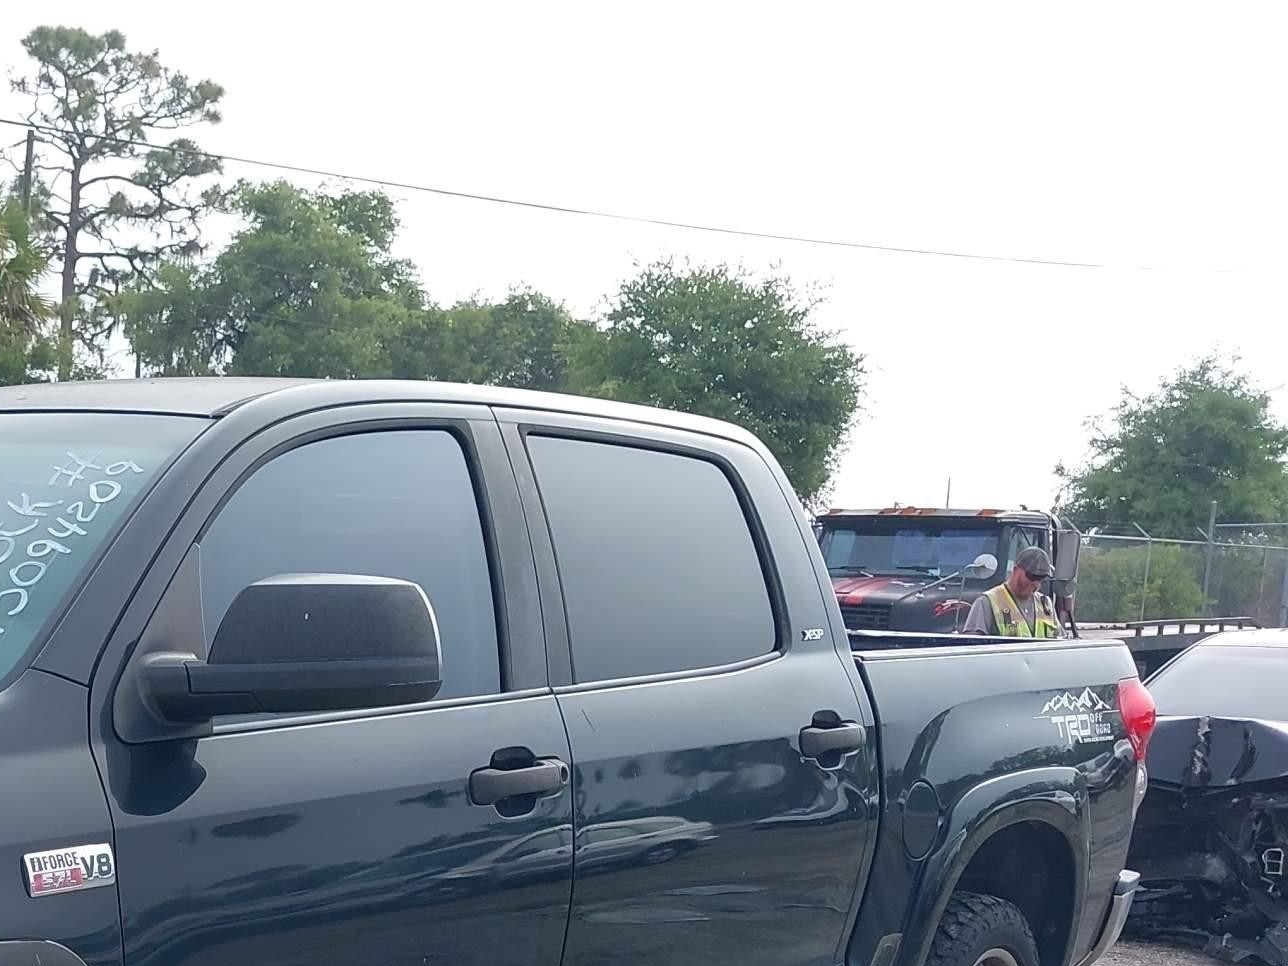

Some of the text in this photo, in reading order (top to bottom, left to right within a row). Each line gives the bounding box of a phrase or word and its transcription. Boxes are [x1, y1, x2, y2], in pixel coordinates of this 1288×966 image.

[48, 450, 102, 488] #
[1050, 713, 1092, 745] TRD
[80, 852, 112, 879] V8
